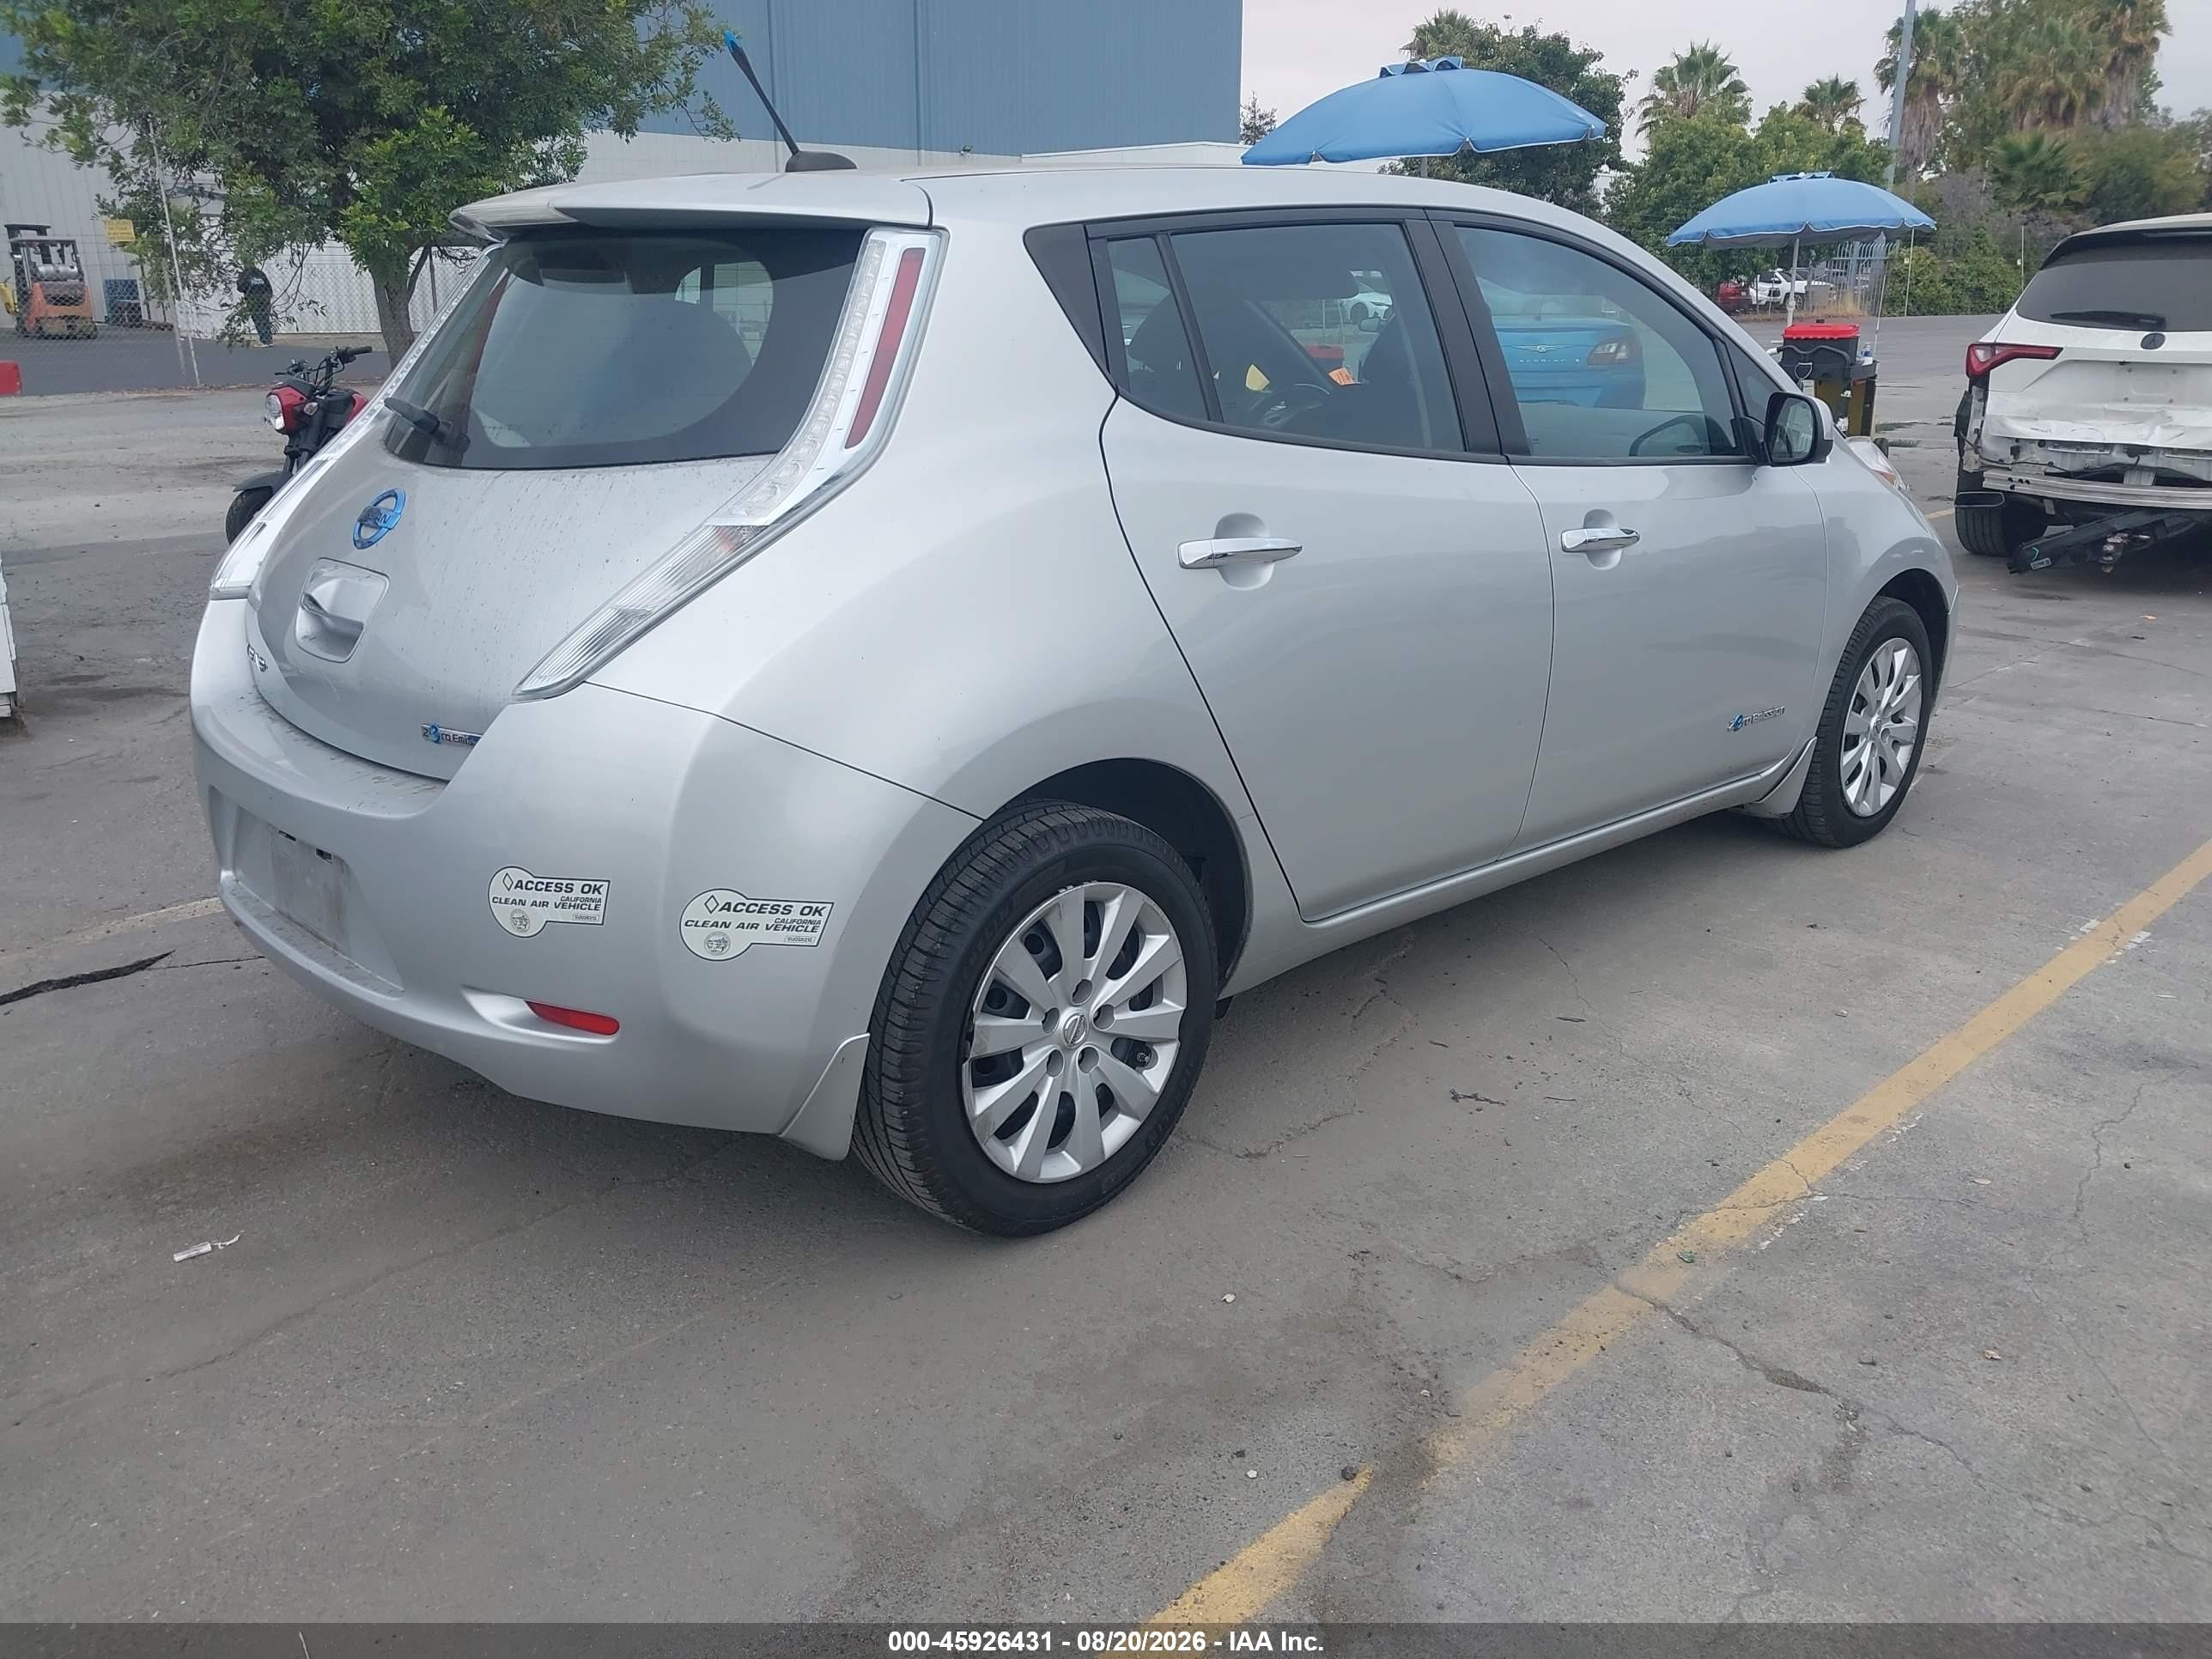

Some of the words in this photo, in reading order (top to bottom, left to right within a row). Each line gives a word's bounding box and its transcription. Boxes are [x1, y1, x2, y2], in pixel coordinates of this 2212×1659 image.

[514, 879, 574, 894] ACCESS
[580, 883, 605, 895] OK
[492, 896, 527, 907] CLEAN
[530, 900, 550, 908] AIR
[554, 902, 601, 912] VEHICLE
[560, 896, 602, 904] CALIFORNIA
[718, 902, 793, 915] ACCESS
[799, 905, 828, 917] OK
[684, 920, 732, 929] CLEAN
[765, 923, 820, 933] VEHICLE
[774, 917, 822, 926] CALIFORNIA
